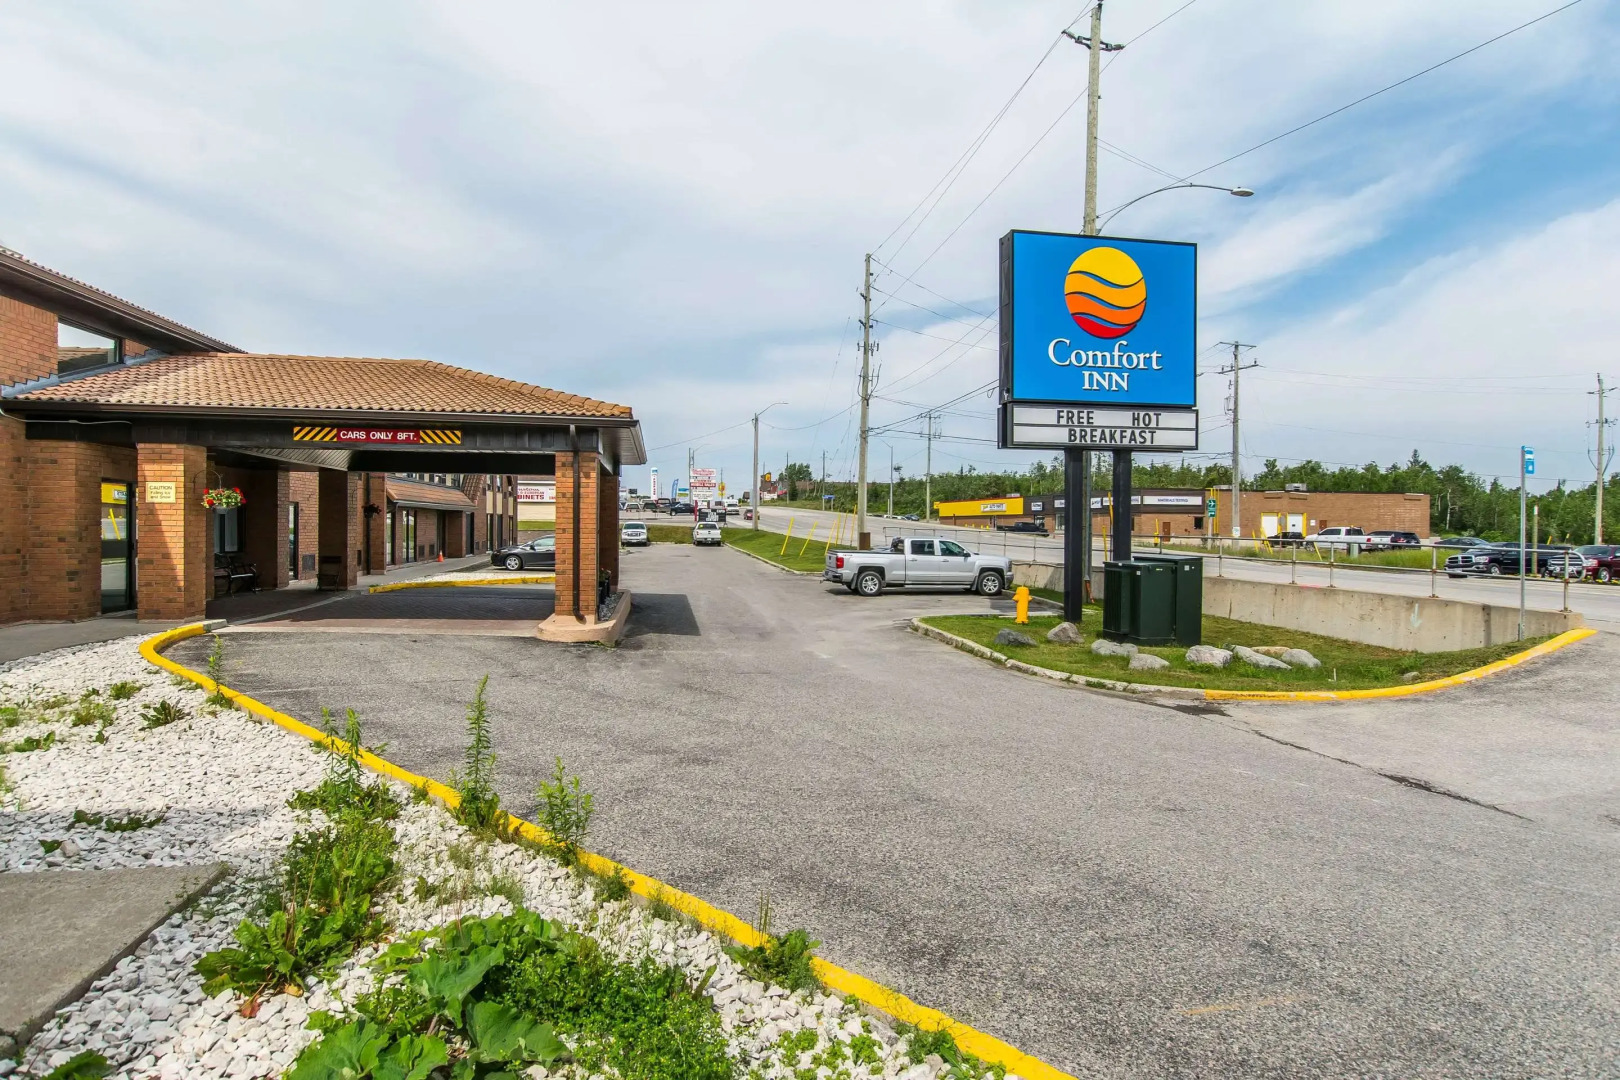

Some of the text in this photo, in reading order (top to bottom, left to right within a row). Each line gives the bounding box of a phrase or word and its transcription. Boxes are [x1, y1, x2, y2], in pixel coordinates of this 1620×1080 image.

[1048, 338, 1163, 370] Comfort
[1082, 370, 1130, 392] INN
[1056, 410, 1162, 427] FREE HOT
[340, 431, 417, 441] CARS ONLY 8FT.
[1068, 428, 1157, 445] BREAKFAST
